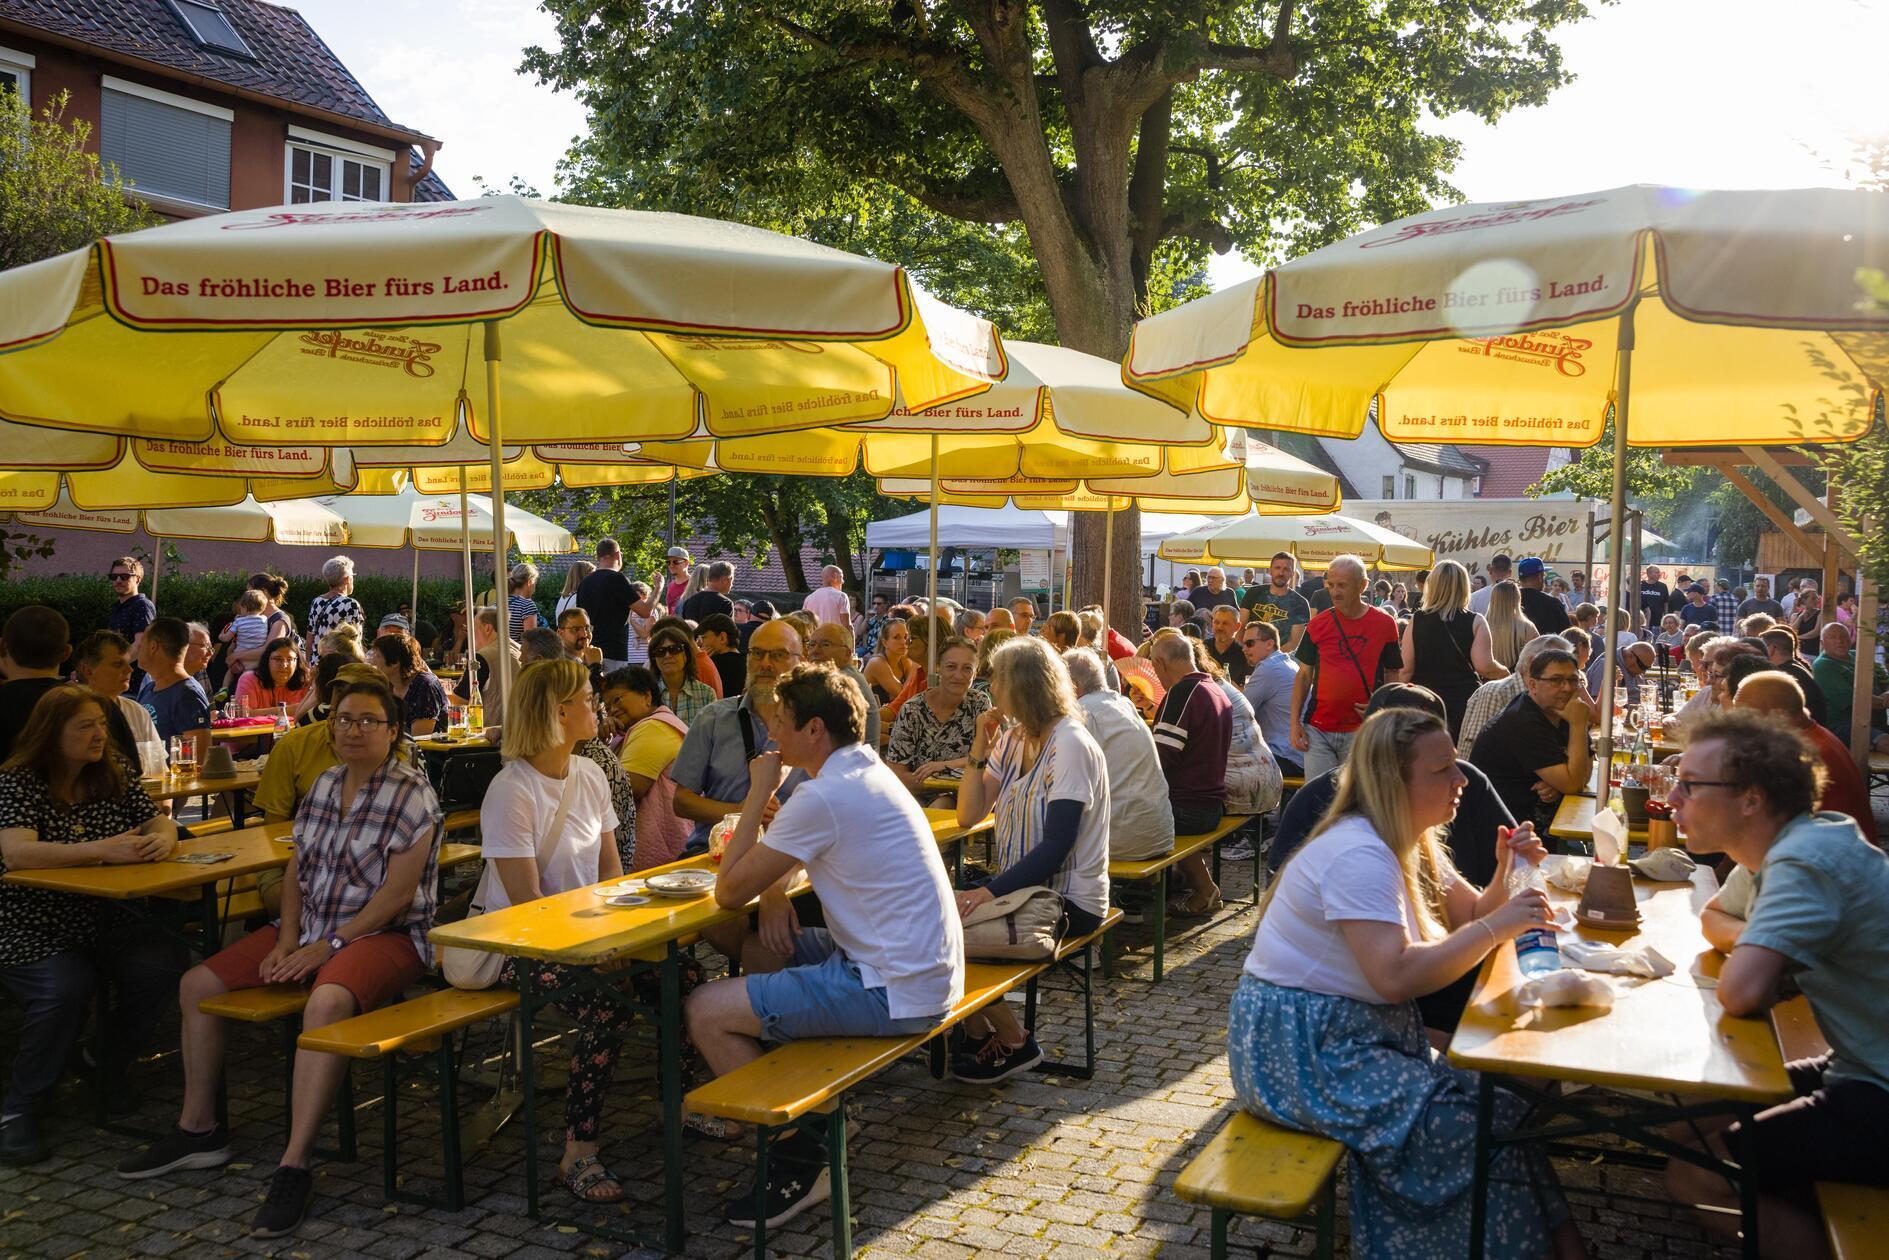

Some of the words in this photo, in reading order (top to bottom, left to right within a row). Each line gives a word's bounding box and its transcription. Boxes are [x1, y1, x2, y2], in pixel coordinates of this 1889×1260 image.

[141, 277, 189, 296] Das
[199, 278, 315, 297] fröhliche
[324, 279, 376, 297] Bier
[384, 278, 434, 297] fürs
[443, 271, 509, 294] Land.
[1297, 303, 1336, 320] Das
[1342, 296, 1436, 318] fröhliche
[1443, 291, 1489, 308] Bier
[1496, 287, 1541, 306] fürs
[1548, 275, 1609, 299] Land.
[924, 407, 951, 418] Bier
[956, 407, 982, 418] fürs
[987, 407, 1023, 418] Land.
[146, 440, 170, 453] Das
[170, 442, 220, 457] fröhliche
[224, 446, 248, 458] Bier
[251, 447, 274, 459] fürs
[278, 448, 312, 461] Land.
[602, 443, 622, 451] Bier
[1311, 489, 1329, 498] Land.
[42, 511, 76, 521] fröhliche
[96, 515, 111, 523] fürs
[1427, 526, 1512, 554] Kühles
[1519, 514, 1579, 541] Bier
